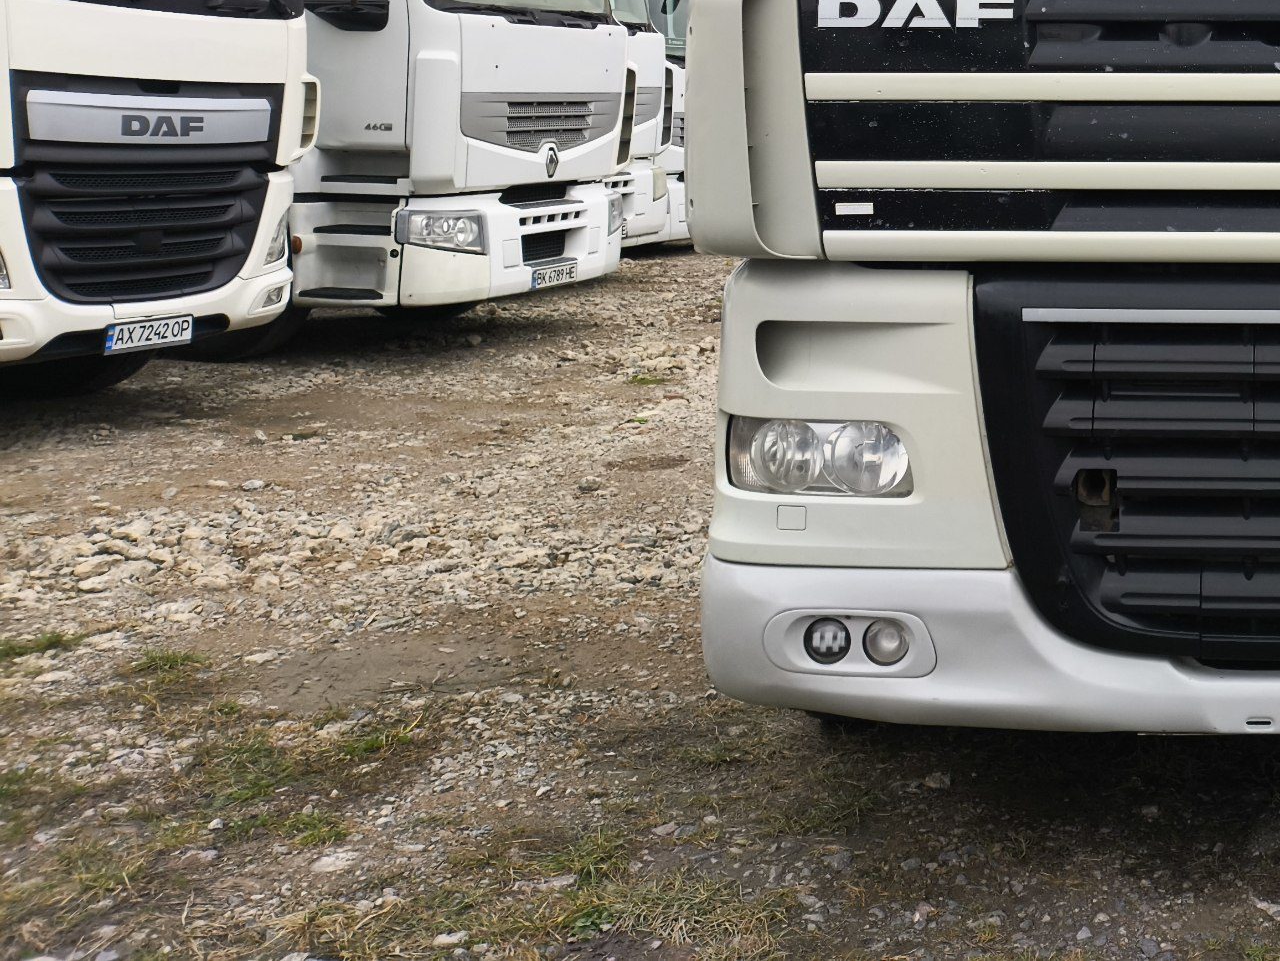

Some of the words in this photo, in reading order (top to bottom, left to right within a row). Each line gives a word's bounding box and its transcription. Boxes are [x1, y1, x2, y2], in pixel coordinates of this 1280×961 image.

[121, 114, 204, 137] DAF
[536, 271, 548, 285] BK
[548, 269, 564, 283] 6789
[564, 266, 575, 280] HE
[114, 326, 137, 345] AX
[137, 322, 170, 342] 7242
[171, 319, 190, 337] OP
